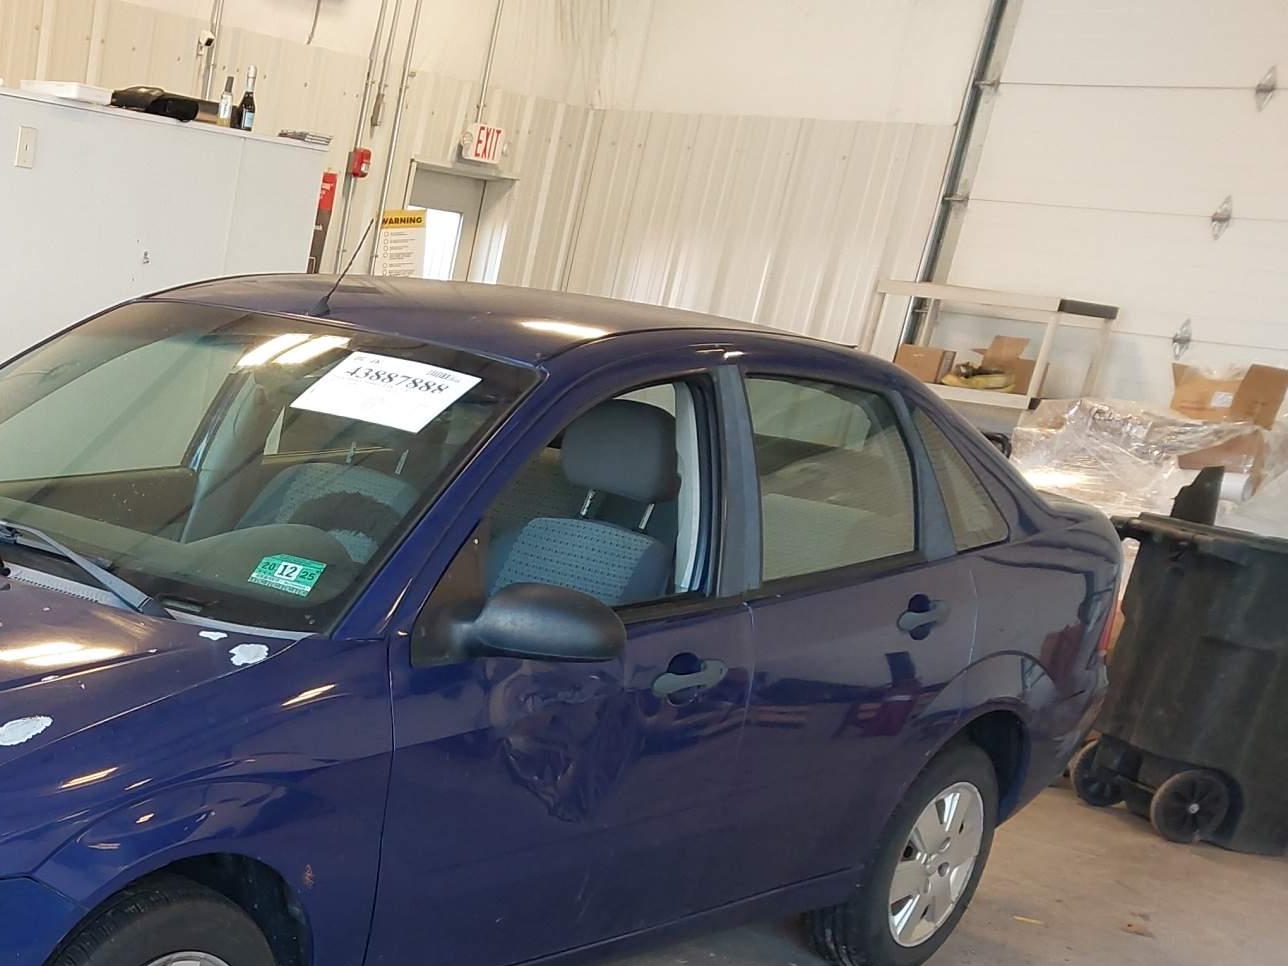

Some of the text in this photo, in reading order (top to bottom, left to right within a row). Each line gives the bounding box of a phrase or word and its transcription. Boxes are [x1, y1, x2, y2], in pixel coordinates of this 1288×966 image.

[474, 126, 502, 160] EXIT
[382, 216, 423, 225] WARNING
[346, 366, 449, 393] 43887888
[261, 561, 316, 581] 20 12 25
